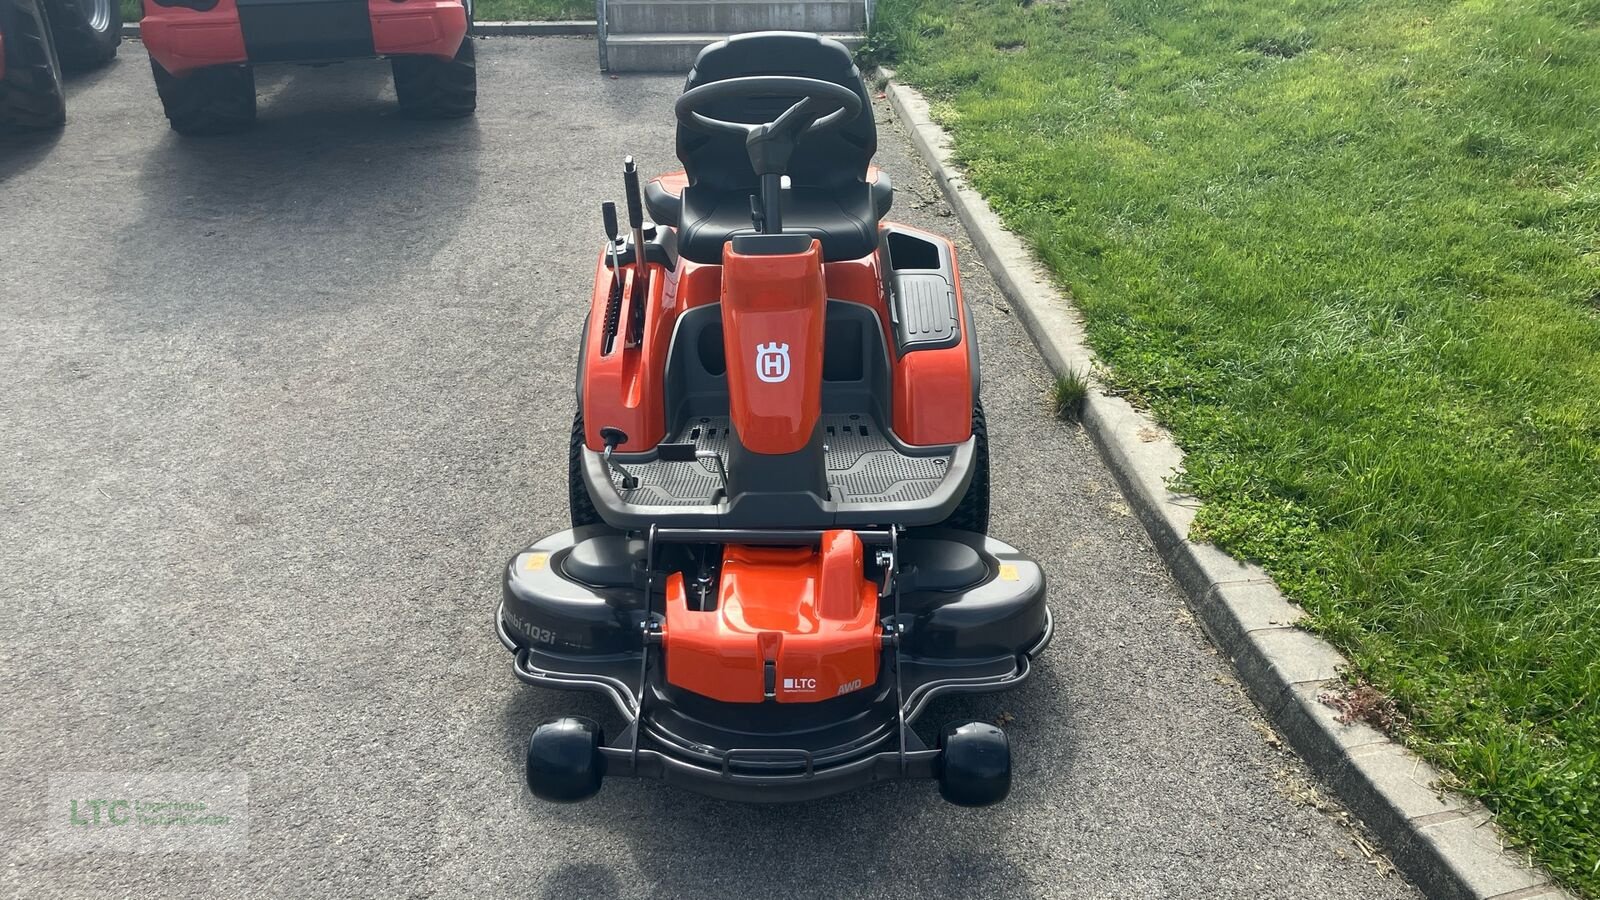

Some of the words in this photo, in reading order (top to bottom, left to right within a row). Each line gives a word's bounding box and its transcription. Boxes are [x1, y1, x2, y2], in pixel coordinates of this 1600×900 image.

[524, 623, 557, 645] 103i
[794, 679, 816, 689] LTC
[838, 679, 862, 696] AWD
